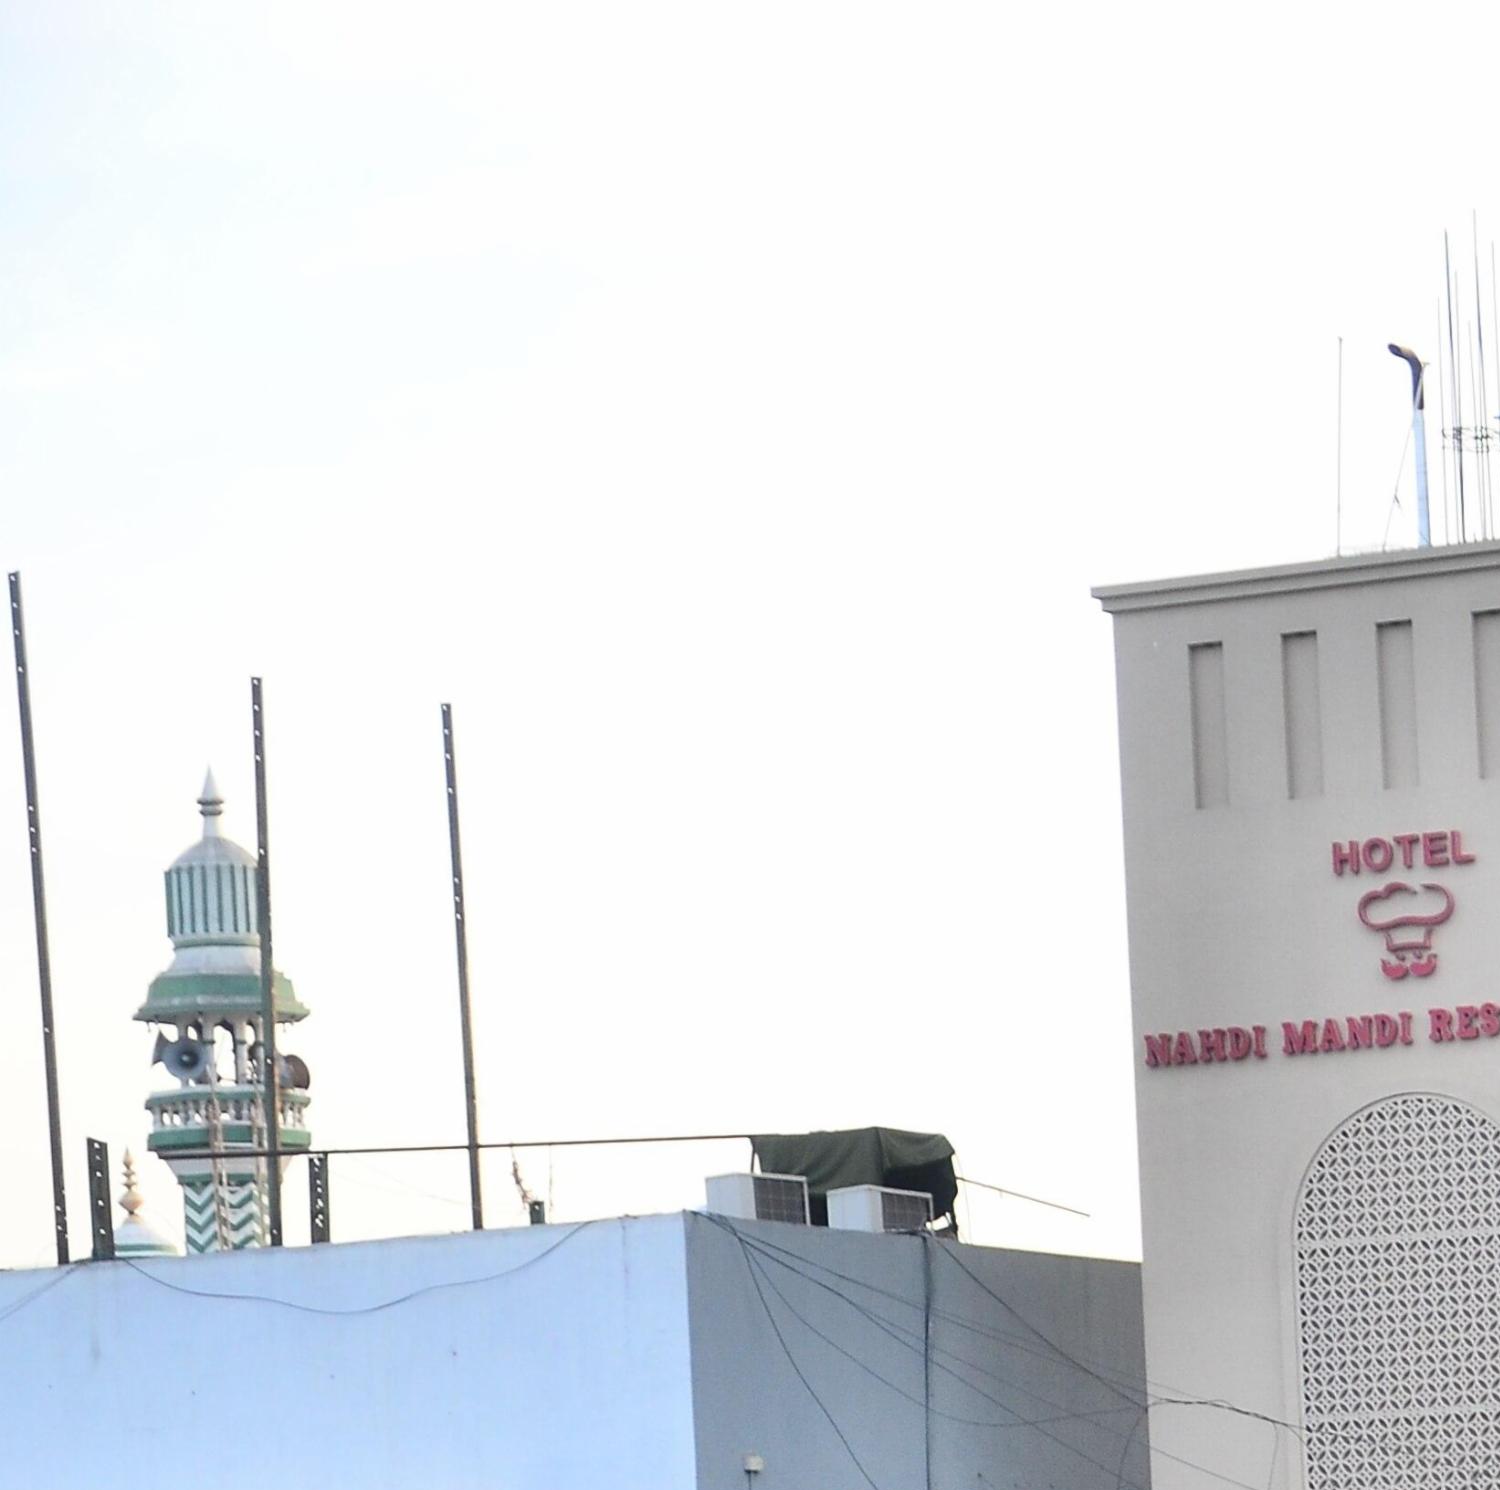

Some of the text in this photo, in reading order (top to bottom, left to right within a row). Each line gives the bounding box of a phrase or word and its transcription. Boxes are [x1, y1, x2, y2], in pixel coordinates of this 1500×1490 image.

[1331, 830, 1476, 876] HOTEL
[1144, 1024, 1267, 1069] NAHDI
[1282, 1011, 1414, 1056] MANDI
